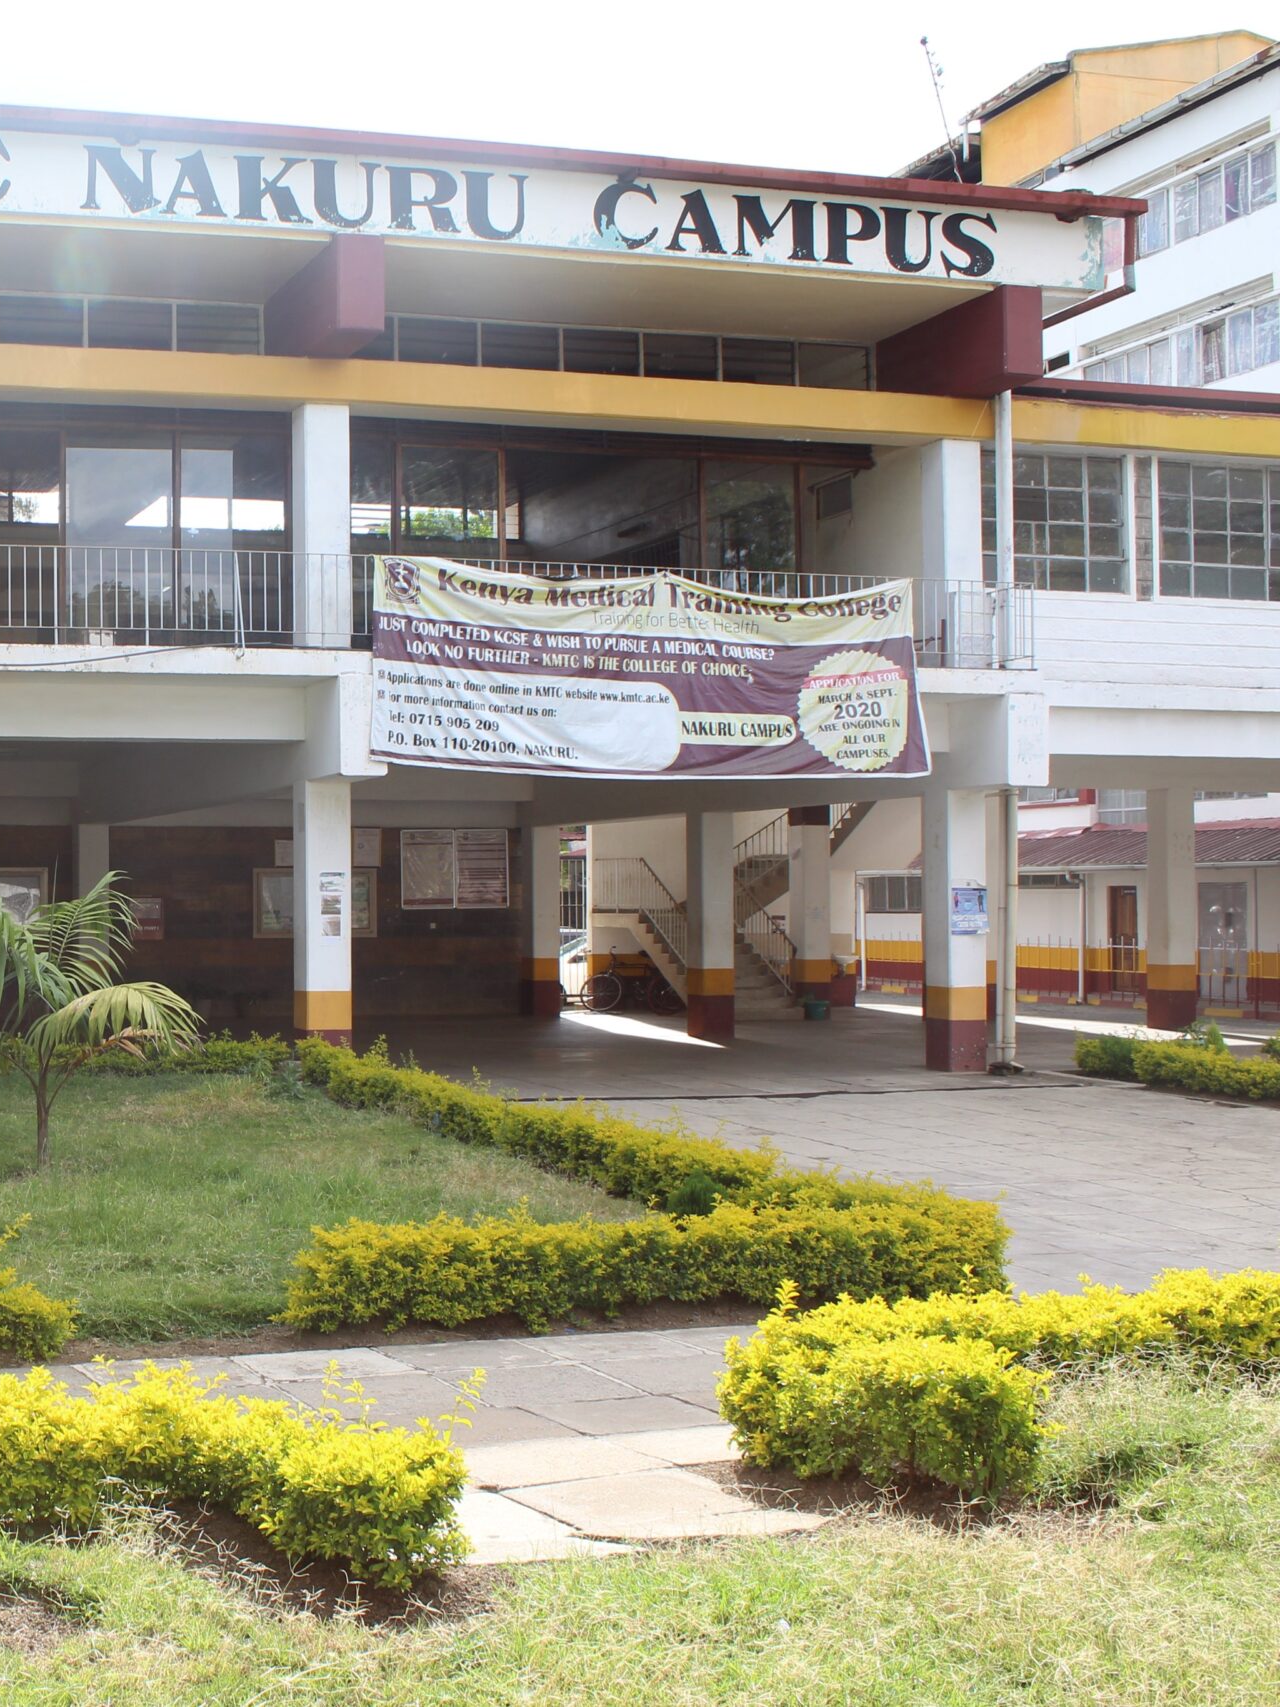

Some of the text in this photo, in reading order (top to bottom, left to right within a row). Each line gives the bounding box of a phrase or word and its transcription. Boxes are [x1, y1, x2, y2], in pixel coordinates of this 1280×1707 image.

[79, 143, 529, 240] NAKURU
[593, 183, 998, 277] CAMPUS
[437, 568, 901, 622] Kenya Medical Training College
[592, 610, 760, 635] Training for Better Health
[379, 616, 774, 661] JUST COMPLETED KCSE & WISH TO PURSUE A MEDICAL COURSE?
[406, 639, 441, 657] LOOK
[444, 645, 463, 660] NO
[468, 647, 530, 665] FURTHER
[542, 653, 580, 669] KMTC
[583, 655, 595, 669] IS
[598, 656, 620, 671] THE
[622, 658, 678, 674] COLLEGE
[681, 660, 698, 674] OF
[387, 671, 670, 704] Applications are done online in KMTC website www.kmtc.ac.ke
[809, 671, 900, 689] APPLICATION FOR
[404, 695, 429, 706] more
[432, 696, 486, 712] information
[488, 702, 523, 716] contact
[526, 707, 539, 716] us
[541, 707, 557, 718] on:
[818, 688, 897, 704] MARCH & SEPT.
[388, 710, 499, 732] Tel: 0715 905 209
[833, 701, 881, 720] 2020
[681, 720, 793, 738] NAKURU CAMPUS
[818, 723, 839, 733] ARE
[842, 719, 889, 730] ONGOING
[388, 730, 408, 746] P.O.
[413, 733, 437, 748] Box
[524, 743, 578, 760] NAKURU.
[842, 733, 885, 745] ALL OUR
[836, 748, 890, 760] CAMPUSES.
